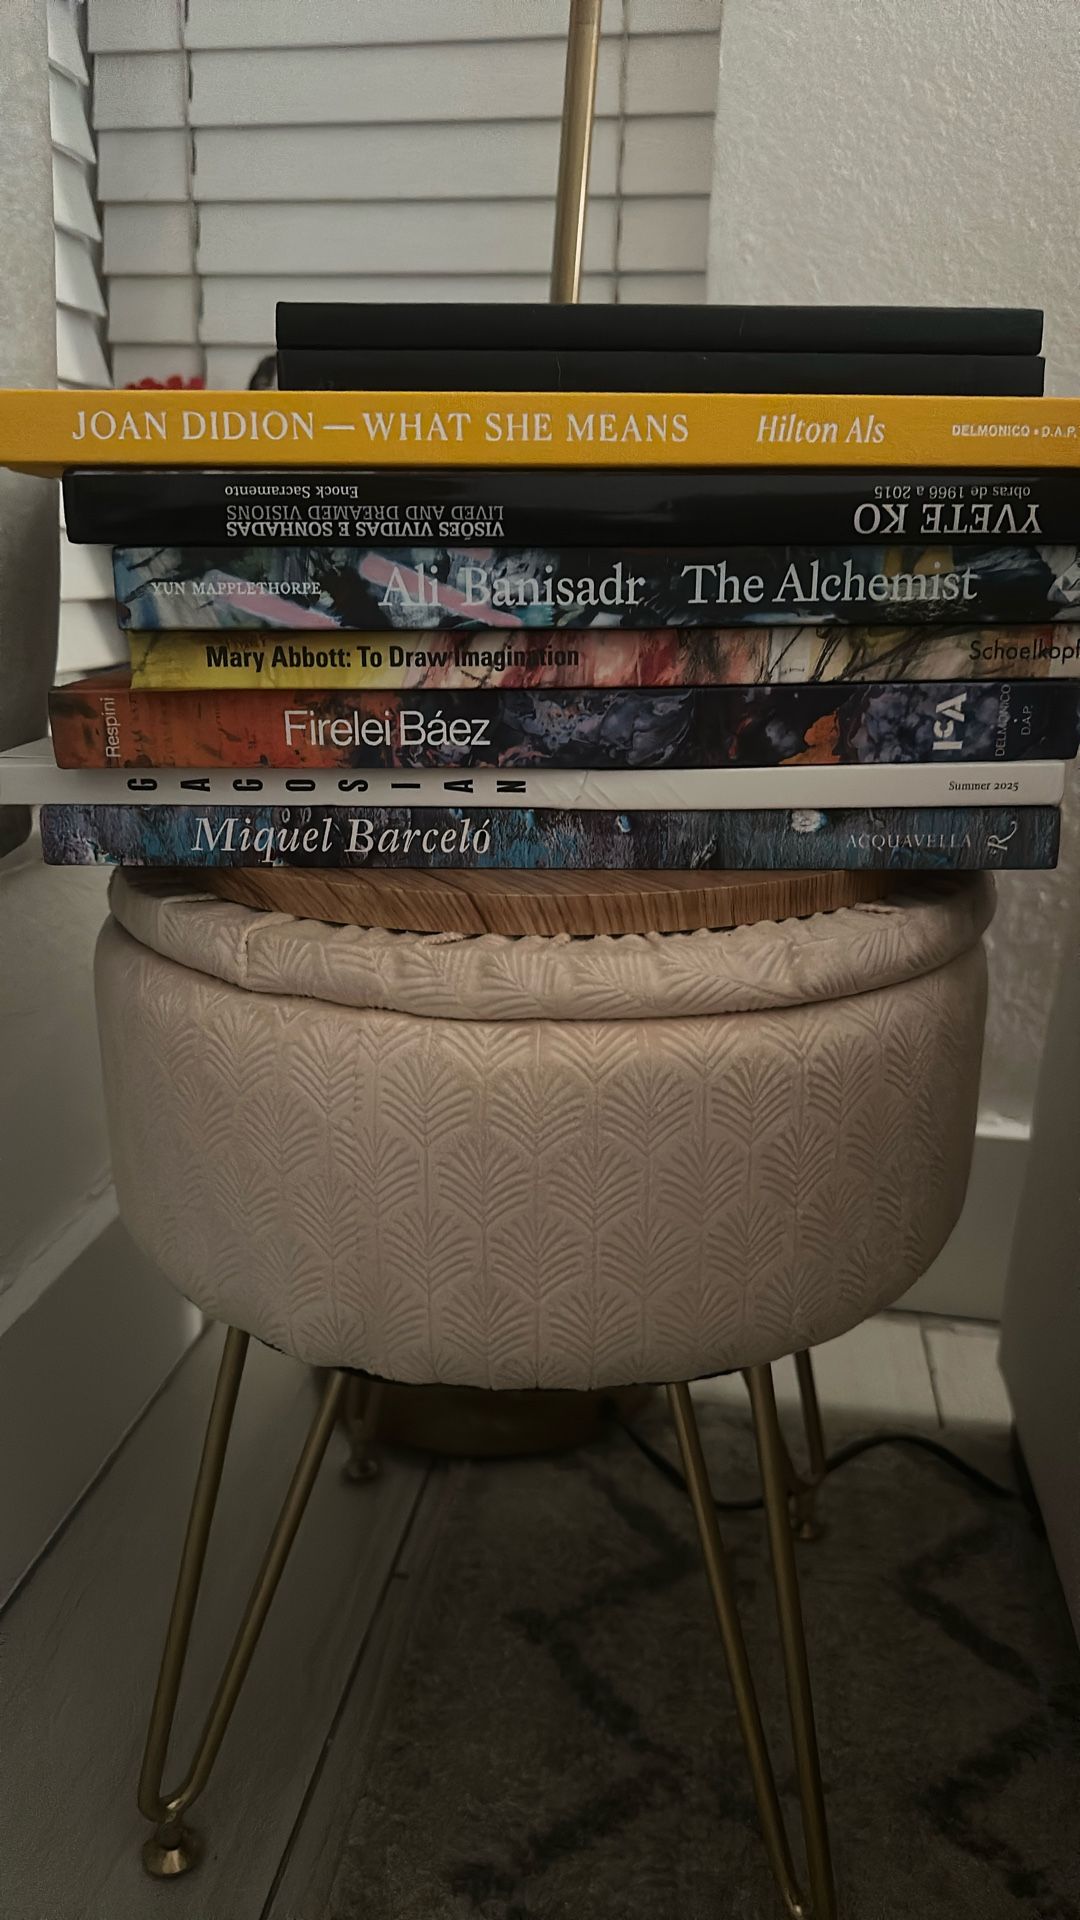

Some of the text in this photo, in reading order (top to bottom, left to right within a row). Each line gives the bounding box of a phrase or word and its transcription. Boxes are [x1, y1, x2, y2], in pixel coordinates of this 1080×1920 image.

[72, 411, 167, 440] JOAN
[182, 411, 314, 440] DIDION
[362, 412, 471, 441] WHAT
[485, 413, 553, 442] SHE
[566, 414, 689, 443] MEANS
[757, 413, 885, 444] Hilton Als
[952, 424, 1030, 437] DELMONICO
[224, 485, 358, 499] Enock Sacramento
[874, 485, 1031, 499] obras de 1966 a 2015
[226, 505, 504, 521] LIVED AND DREAMED VISIONS
[853, 503, 1043, 534] YVETE KO
[226, 521, 505, 541] VISÕES VIVIDAS E SONHADAS
[151, 582, 321, 595] YUN MAPPLETHORPE
[378, 561, 646, 607] Ali Banisadr
[681, 558, 979, 604] The Alchemist
[206, 645, 580, 672] Mary Abbott: To Draw Imagination
[100, 697, 121, 758] Respini
[283, 709, 491, 747] Firelei Báez
[932, 692, 967, 750] ICA
[995, 684, 1011, 757] DELMONICO
[127, 778, 527, 793] GAGOSIAN
[948, 780, 1019, 792] Summer 2025
[191, 817, 491, 863] Miquel Barceló
[846, 833, 971, 851] ACQUAVELLA
